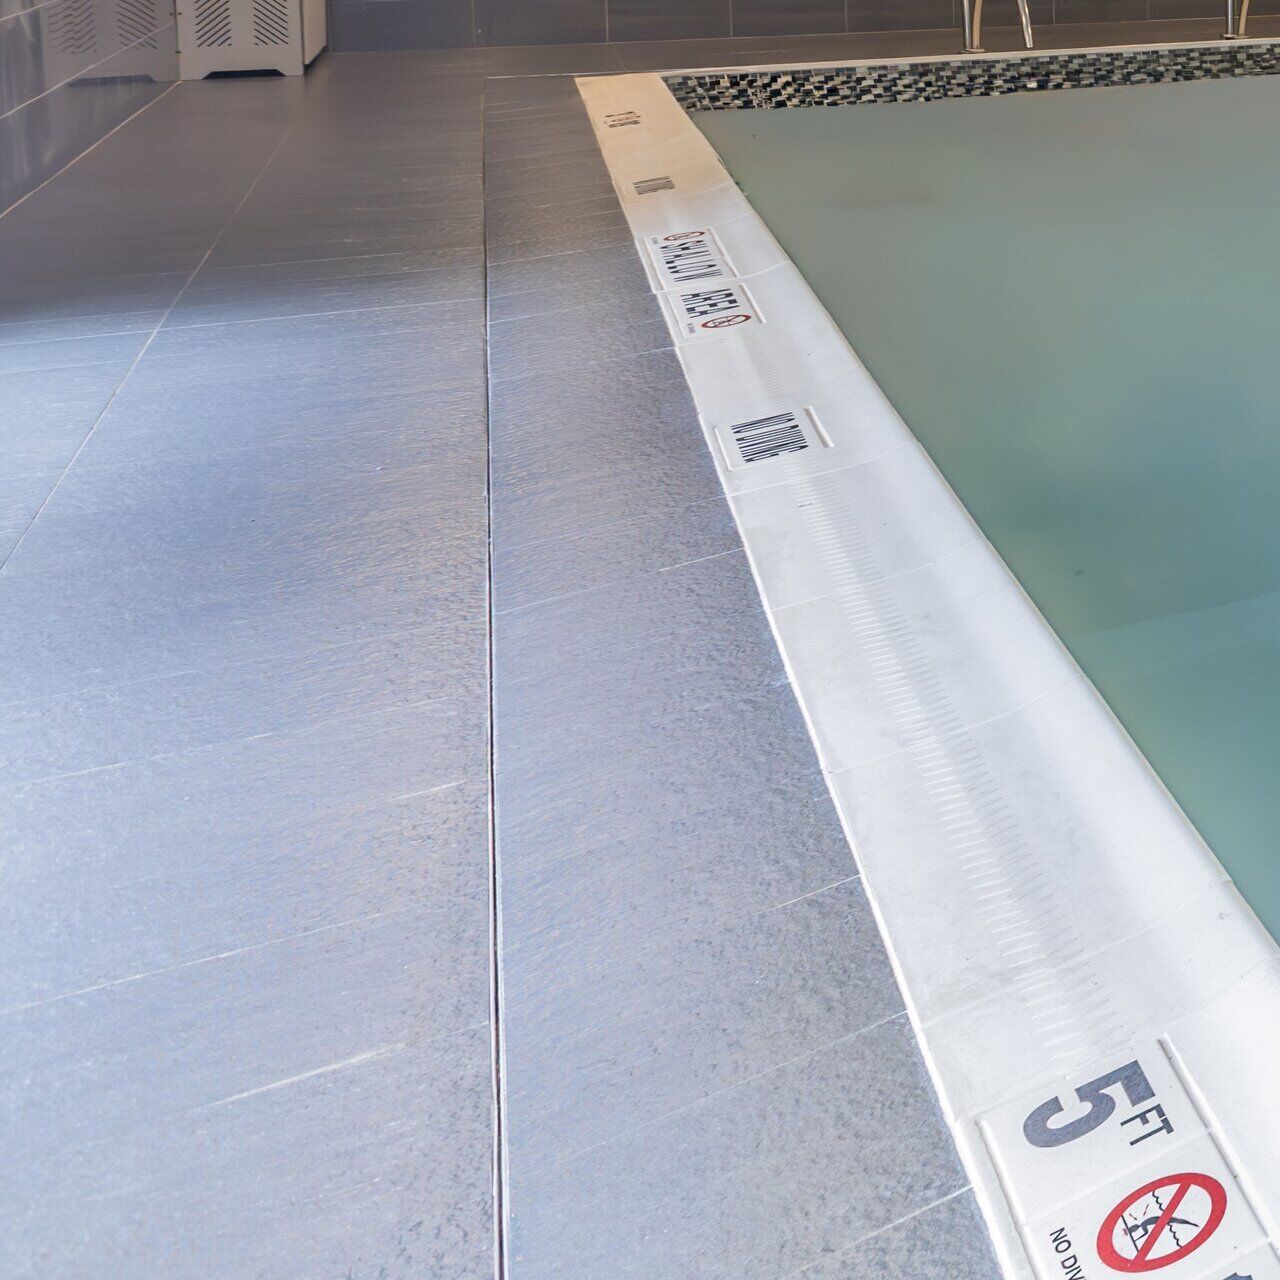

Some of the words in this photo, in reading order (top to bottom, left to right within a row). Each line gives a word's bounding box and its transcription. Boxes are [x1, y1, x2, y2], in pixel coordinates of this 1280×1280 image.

[660, 240, 724, 282] SHALLOW
[680, 288, 740, 319] AREA
[730, 412, 796, 434] NO
[735, 424, 809, 463] DIVING
[1023, 1059, 1156, 1148] 5
[1120, 1103, 1174, 1146] FT
[1050, 1227, 1071, 1253] NO
[1061, 1254, 1087, 1280] DIV
